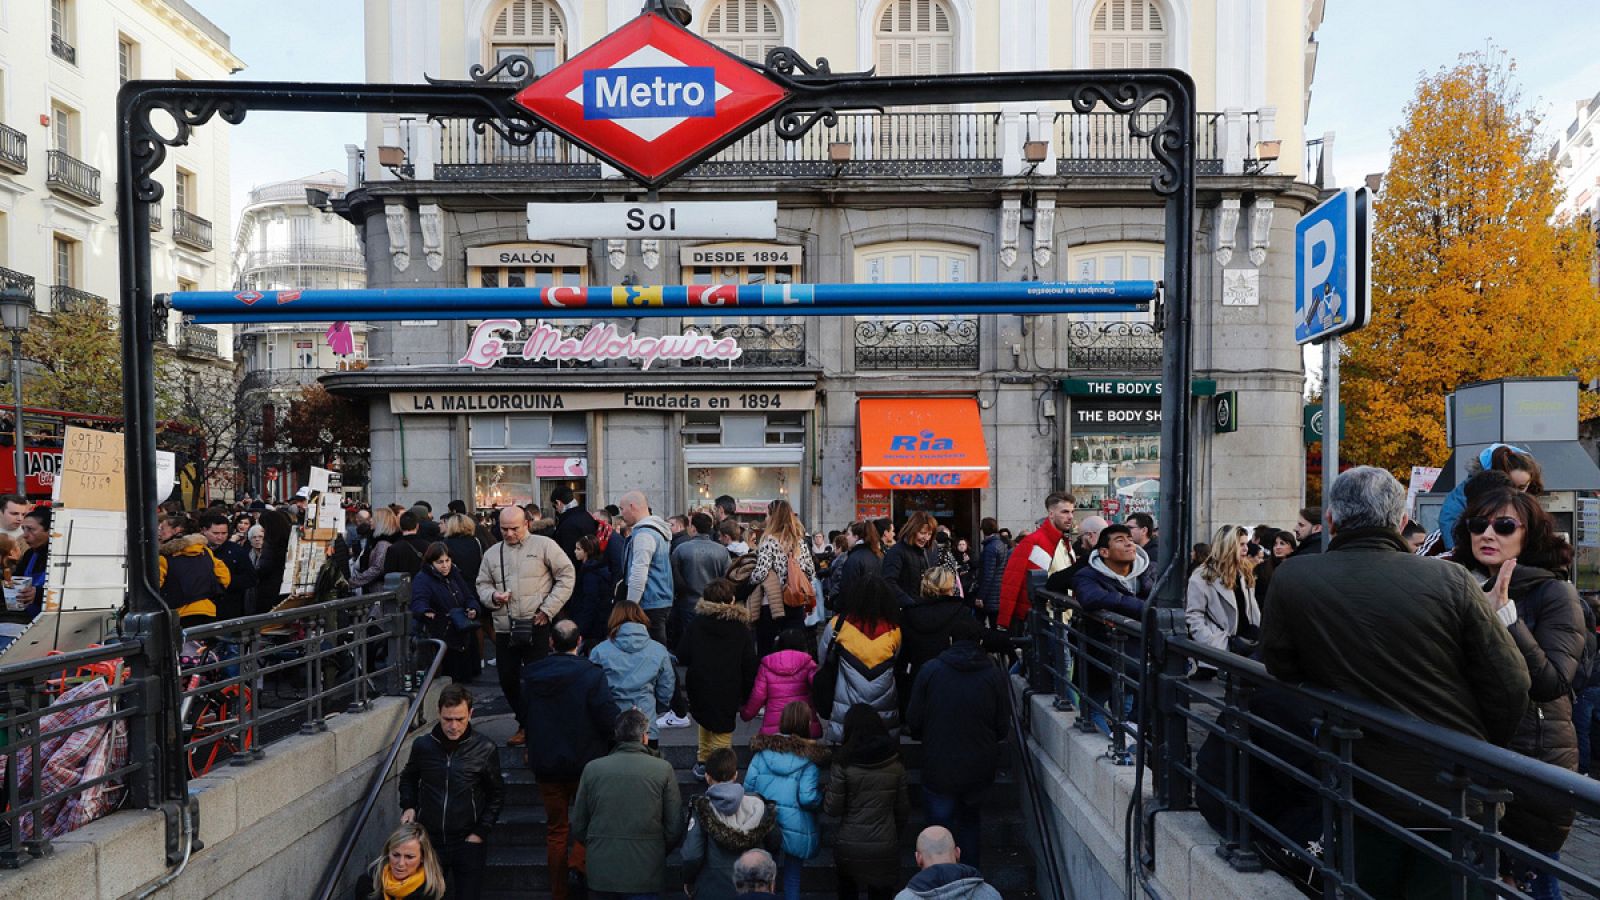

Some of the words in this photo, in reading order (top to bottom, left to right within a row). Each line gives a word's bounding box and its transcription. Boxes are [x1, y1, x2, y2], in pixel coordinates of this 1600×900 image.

[595, 76, 705, 108] Metro
[626, 207, 676, 231] Sol
[499, 250, 555, 264] SALÓN
[693, 251, 745, 263] DESDE
[752, 251, 789, 263] 1894
[1304, 219, 1336, 321] P
[458, 320, 521, 368] La
[523, 320, 742, 370] Mallorquina
[1087, 382, 1112, 393] THE
[1116, 383, 1152, 394] BODY
[413, 395, 434, 410] LA
[441, 394, 565, 410] MALLORQUINA
[623, 392, 701, 409] Fundada
[708, 396, 730, 409] en
[739, 392, 781, 409] 1894
[1077, 410, 1103, 421] THE
[1107, 410, 1143, 421] BODY
[1145, 410, 1162, 421] SH
[890, 429, 953, 451] Ria
[889, 473, 961, 485] CHANGE
